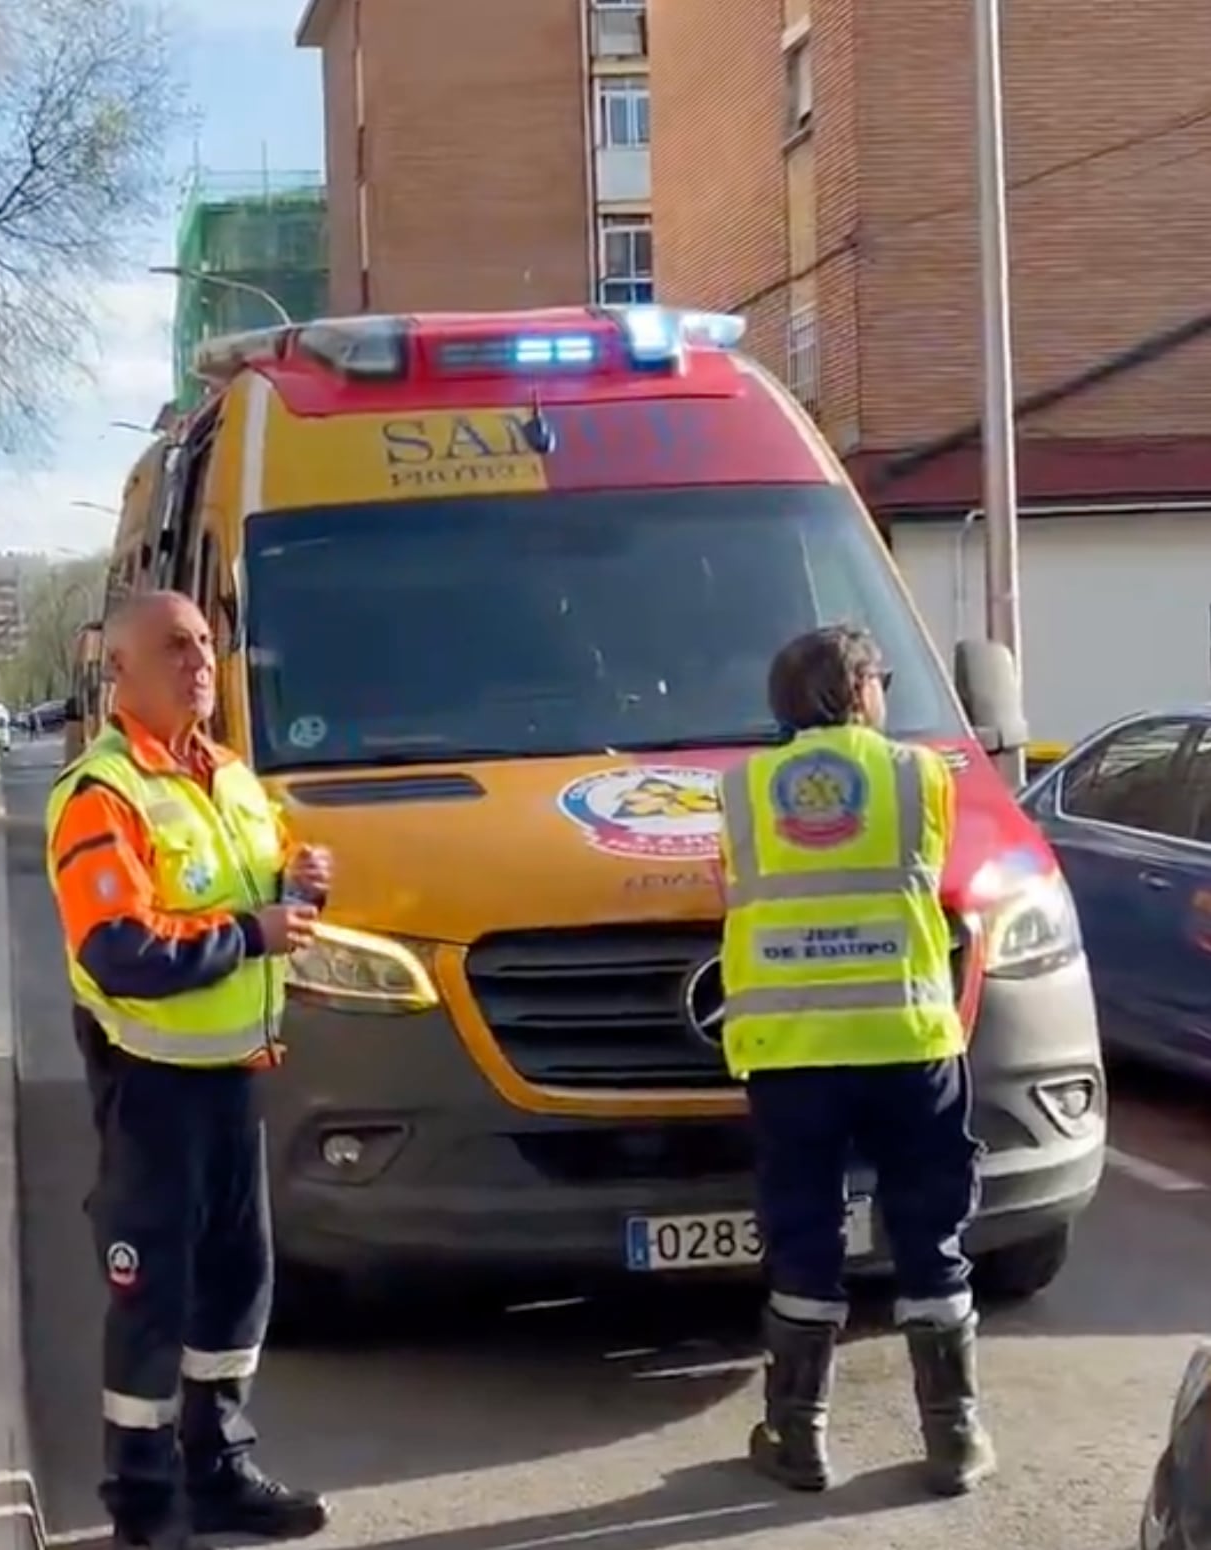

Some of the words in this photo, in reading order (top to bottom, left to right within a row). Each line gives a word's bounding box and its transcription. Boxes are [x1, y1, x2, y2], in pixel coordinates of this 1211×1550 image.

[803, 926, 858, 942] JEFE
[763, 946, 794, 960] DE
[805, 940, 898, 959] EQUIPO
[656, 1219, 764, 1262] 0283
